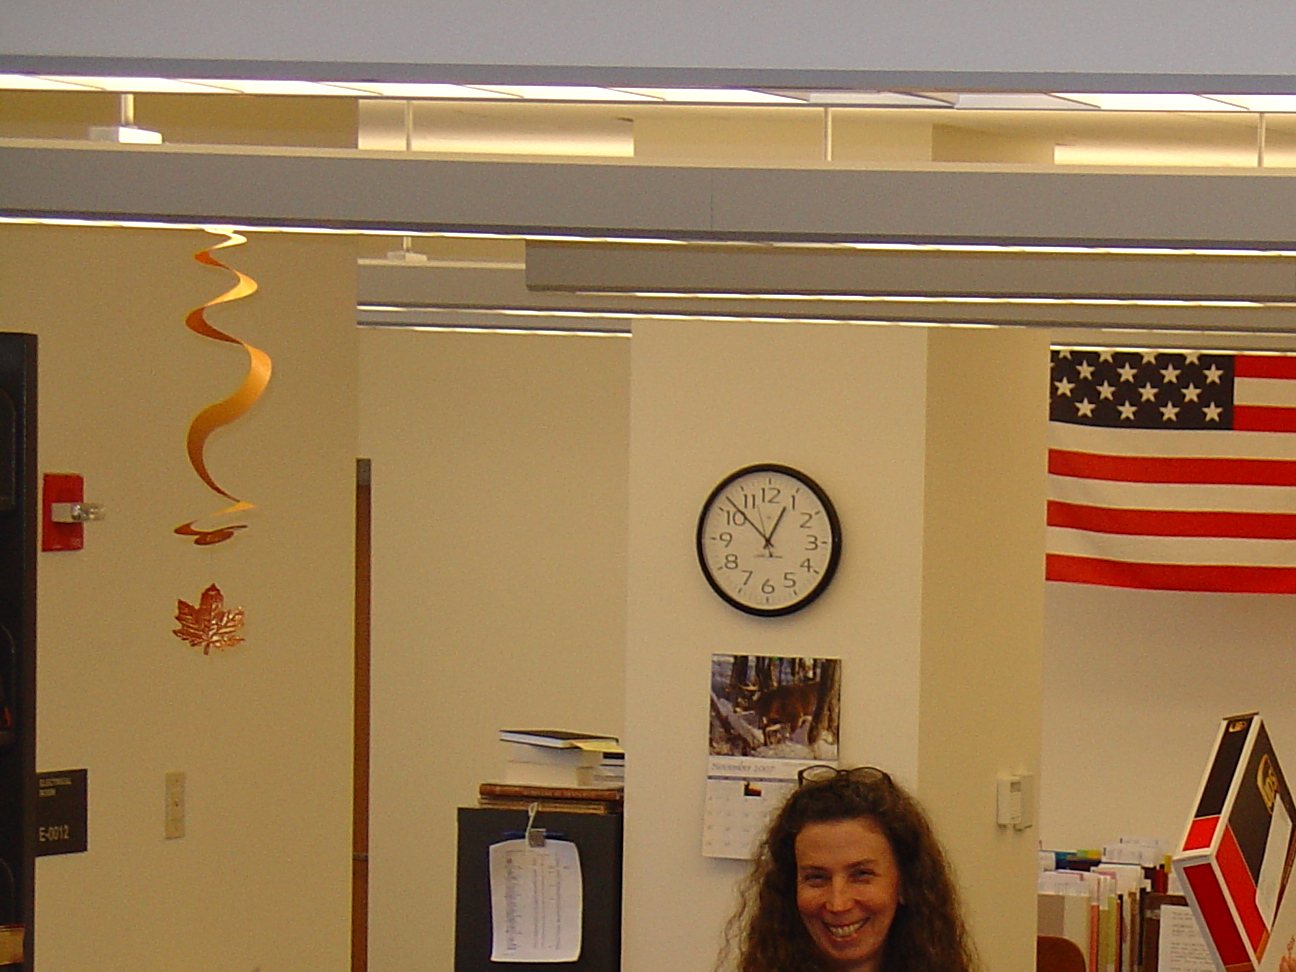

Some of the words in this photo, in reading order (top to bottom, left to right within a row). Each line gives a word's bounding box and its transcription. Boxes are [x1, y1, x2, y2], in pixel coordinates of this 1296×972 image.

[743, 493, 756, 509] 11
[761, 487, 781, 504] 12
[790, 494, 796, 510] 1
[726, 510, 747, 526] 10
[799, 512, 813, 529] 2
[719, 531, 733, 548] 9
[805, 535, 819, 551] 3
[724, 553, 739, 570] 8
[799, 558, 813, 573] 4
[741, 570, 754, 586] 7
[783, 572, 797, 588] 5
[761, 578, 775, 595] 6
[39, 825, 69, 842] E-0012
